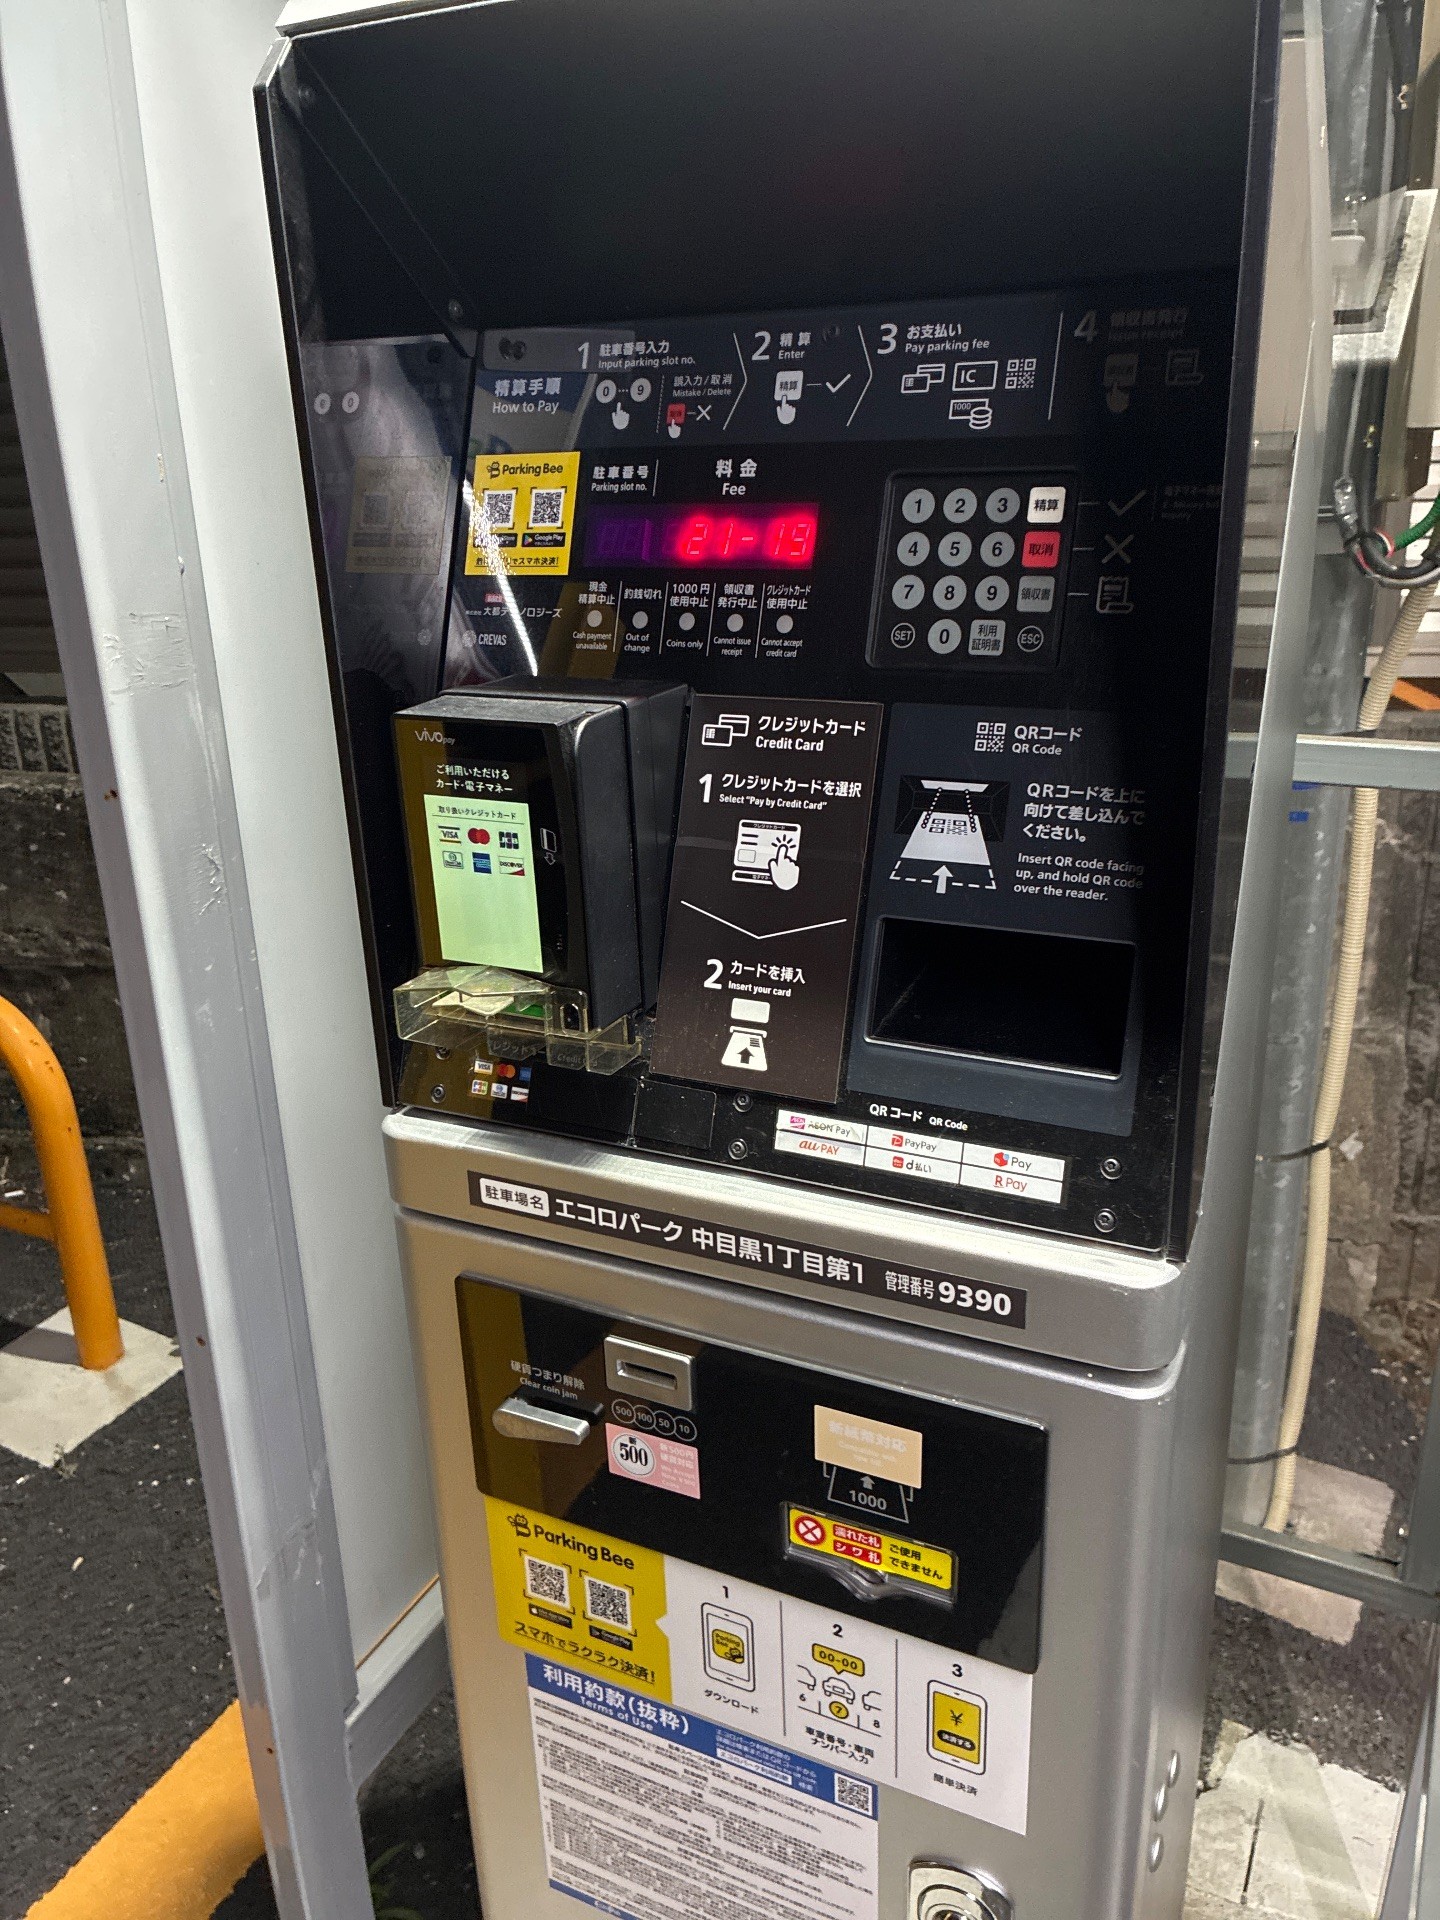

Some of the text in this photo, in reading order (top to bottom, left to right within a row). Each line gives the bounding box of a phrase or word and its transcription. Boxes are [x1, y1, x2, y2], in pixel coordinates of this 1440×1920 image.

[907, 323, 962, 340] お支払い
[1074, 310, 1098, 342] 4
[752, 330, 771, 361] 2
[779, 332, 811, 347] 精算
[877, 324, 898, 355] 3
[905, 339, 990, 354] Pay parking fee
[578, 342, 589, 369] 1
[599, 340, 670, 357] 駐車番号入力
[778, 350, 805, 360] Enter
[599, 356, 696, 370] Input parking slot no.
[960, 369, 976, 384] IC
[494, 377, 562, 397] 精算手順
[602, 385, 609, 397] 0
[637, 385, 644, 396] 9
[673, 386, 731, 398] Mistake Delete
[779, 380, 799, 391] 精算
[492, 400, 559, 415] How to Pay
[953, 402, 971, 411] 1000
[593, 466, 649, 480] 駐車番号
[716, 459, 757, 478] 料金
[591, 482, 648, 493] Parking slot no.
[722, 483, 746, 495] Fee
[915, 499, 922, 514] 1
[954, 499, 966, 514] 2
[997, 498, 1008, 513] 3
[1034, 499, 1059, 512] 精算
[908, 541, 919, 557] 4
[949, 541, 961, 557] 5
[991, 541, 1003, 557] 6
[1029, 543, 1054, 556] 取消
[589, 581, 608, 592] 現金
[624, 588, 663, 600] 釣銭切れ
[724, 584, 754, 595] 領収書
[766, 585, 811, 596] クレジットカード
[903, 584, 914, 599] 7
[944, 585, 955, 601] 8
[987, 585, 998, 601] 9
[670, 596, 709, 607] 使用中止
[1021, 588, 1051, 601] 領収書
[717, 597, 758, 609] 発行中止
[766, 598, 808, 610] 使用中止
[573, 631, 612, 641] Cash payment
[626, 633, 650, 641] Out of
[895, 630, 912, 641] SET
[939, 629, 950, 644] 0
[978, 625, 997, 637] 利用
[479, 634, 507, 646] CREVAS
[575, 642, 608, 650] unavailable
[666, 639, 704, 649] Coins only
[713, 637, 751, 645] Cannot issue
[761, 638, 803, 648] Cannot accept
[972, 639, 1001, 651] 証明書
[1021, 633, 1040, 645] ESC
[624, 643, 650, 652] change
[721, 647, 742, 657] receipt
[766, 648, 797, 658] credit card
[758, 716, 866, 737] クレジットカード
[1014, 725, 1083, 742] QRコード
[756, 736, 824, 752] Credit Card
[1012, 742, 1062, 755] QR Code
[436, 765, 510, 780] ご利用いただける
[436, 779, 514, 794] カード・電子マネー
[699, 774, 712, 803] 1
[722, 774, 862, 798] クレジットカードを選択
[1026, 783, 1146, 804] QRコードを上に
[719, 794, 802, 809] Select by Credit
[438, 805, 517, 820] 取り扱いクレジットカード
[1023, 803, 1146, 825] 向けて差し込んで
[441, 830, 459, 839] VISA
[1023, 823, 1087, 843] ください。
[1018, 853, 1145, 876] Insert QR code facing
[1016, 868, 1143, 889] up, and hold QR code
[1014, 884, 1109, 901] over the reader.
[704, 959, 724, 990] 2
[730, 960, 806, 984] カードを挿入
[728, 981, 792, 997] Insert your card
[478, 1063, 491, 1071] VISA
[835, 1125, 851, 1137] Pay
[929, 1116, 968, 1131] QR Code
[799, 1140, 840, 1156] au PAY
[904, 1137, 937, 1153] PayPay
[905, 1159, 932, 1174] d払い
[1010, 1156, 1032, 1171] Pay
[1006, 1177, 1028, 1192] Pay
[485, 1185, 544, 1211] 駐車場名
[555, 1198, 863, 1284] エコロパーク 中目黒1丁目第1
[885, 1271, 1012, 1316] 管理番号 9390
[510, 1359, 586, 1391] 硬貨つまり解除
[520, 1377, 578, 1401] Clear coin jam
[615, 1405, 632, 1417] 500
[638, 1412, 653, 1424] 100
[658, 1418, 670, 1428] 50
[680, 1424, 690, 1434] 10
[619, 1442, 648, 1467] 500
[849, 1489, 888, 1511] 1000
[889, 1544, 922, 1561] ご使用
[889, 1556, 943, 1581] できません
[722, 1586, 729, 1599] 1
[833, 1624, 844, 1638] 2
[515, 1620, 656, 1683] スマホでラクラク決済!
[952, 1663, 964, 1677] 3
[704, 1689, 759, 1714] ダウンロード
[799, 1693, 807, 1702] 6
[581, 1696, 654, 1731] Terms of Use
[835, 1706, 843, 1715] 7
[873, 1719, 881, 1729] 8
[811, 1737, 869, 1764] ナンバー入力
[933, 1773, 978, 1797] 簡単決済
